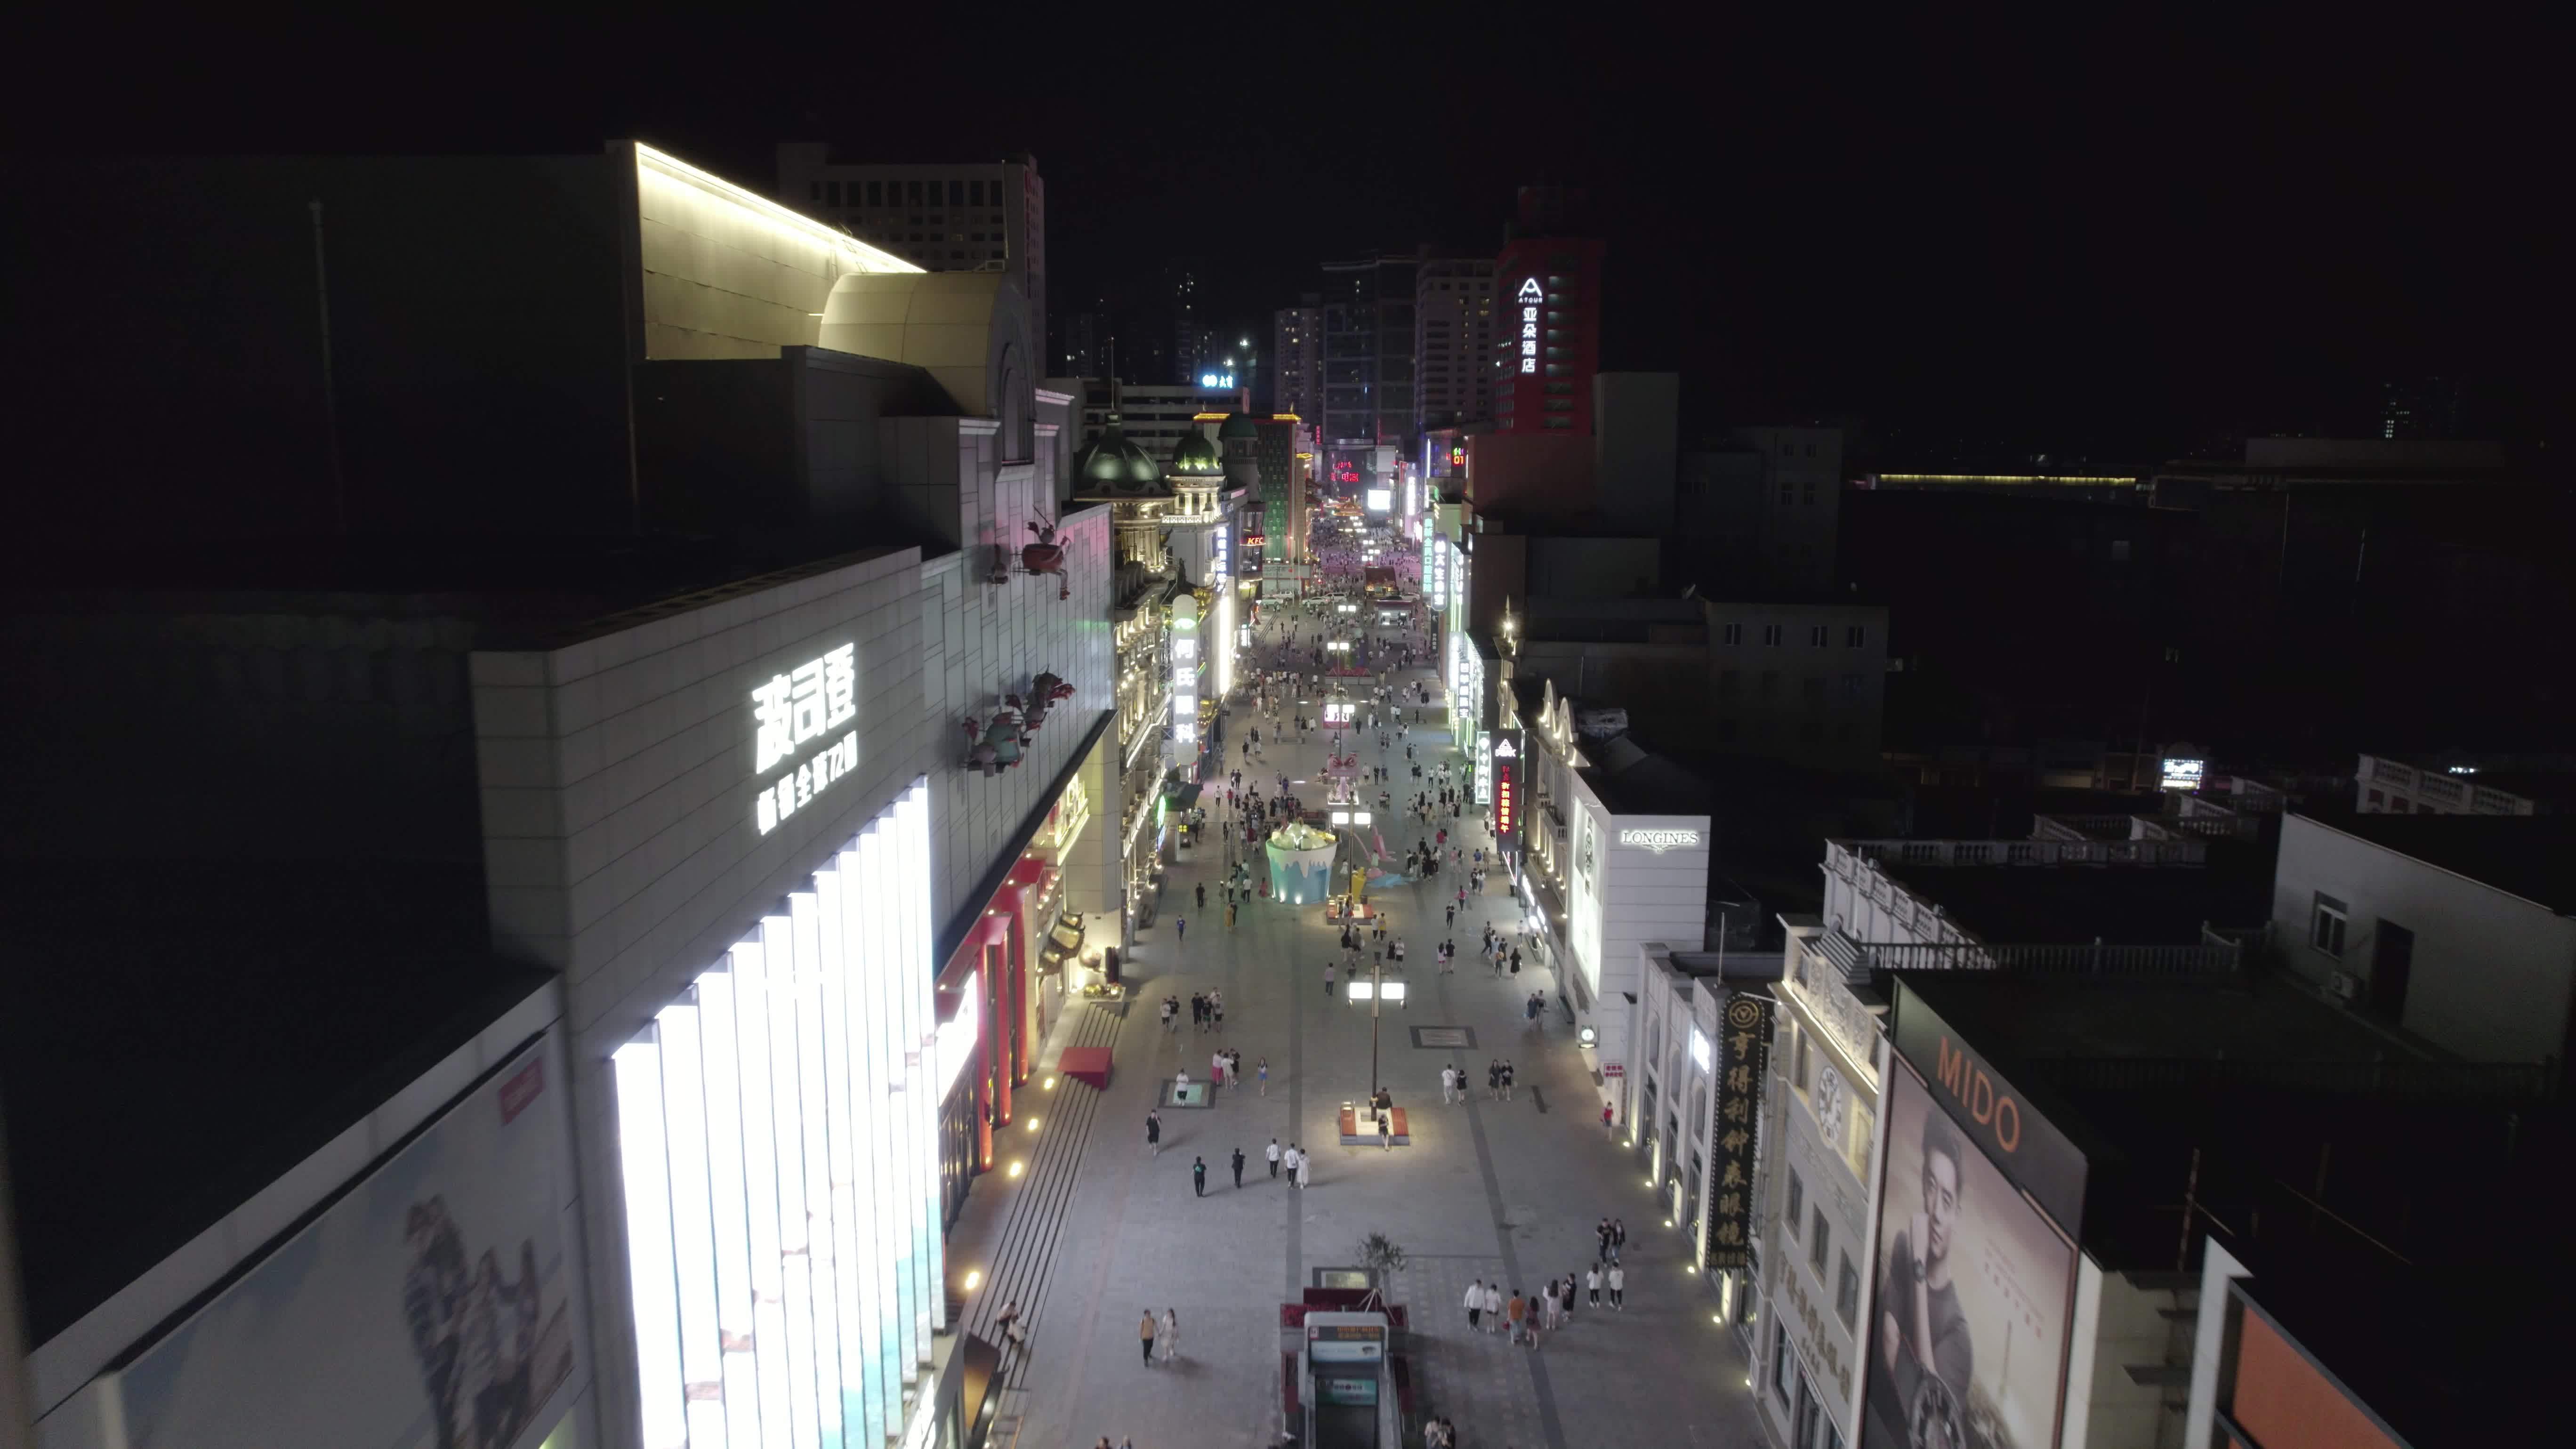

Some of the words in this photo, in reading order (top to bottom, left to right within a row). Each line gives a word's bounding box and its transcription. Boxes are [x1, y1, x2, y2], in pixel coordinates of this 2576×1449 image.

[1521, 307, 1537, 373] 亚朵酒店
[1623, 832, 1699, 844] LONGINES
[1936, 1036, 2021, 1153] MIDO
